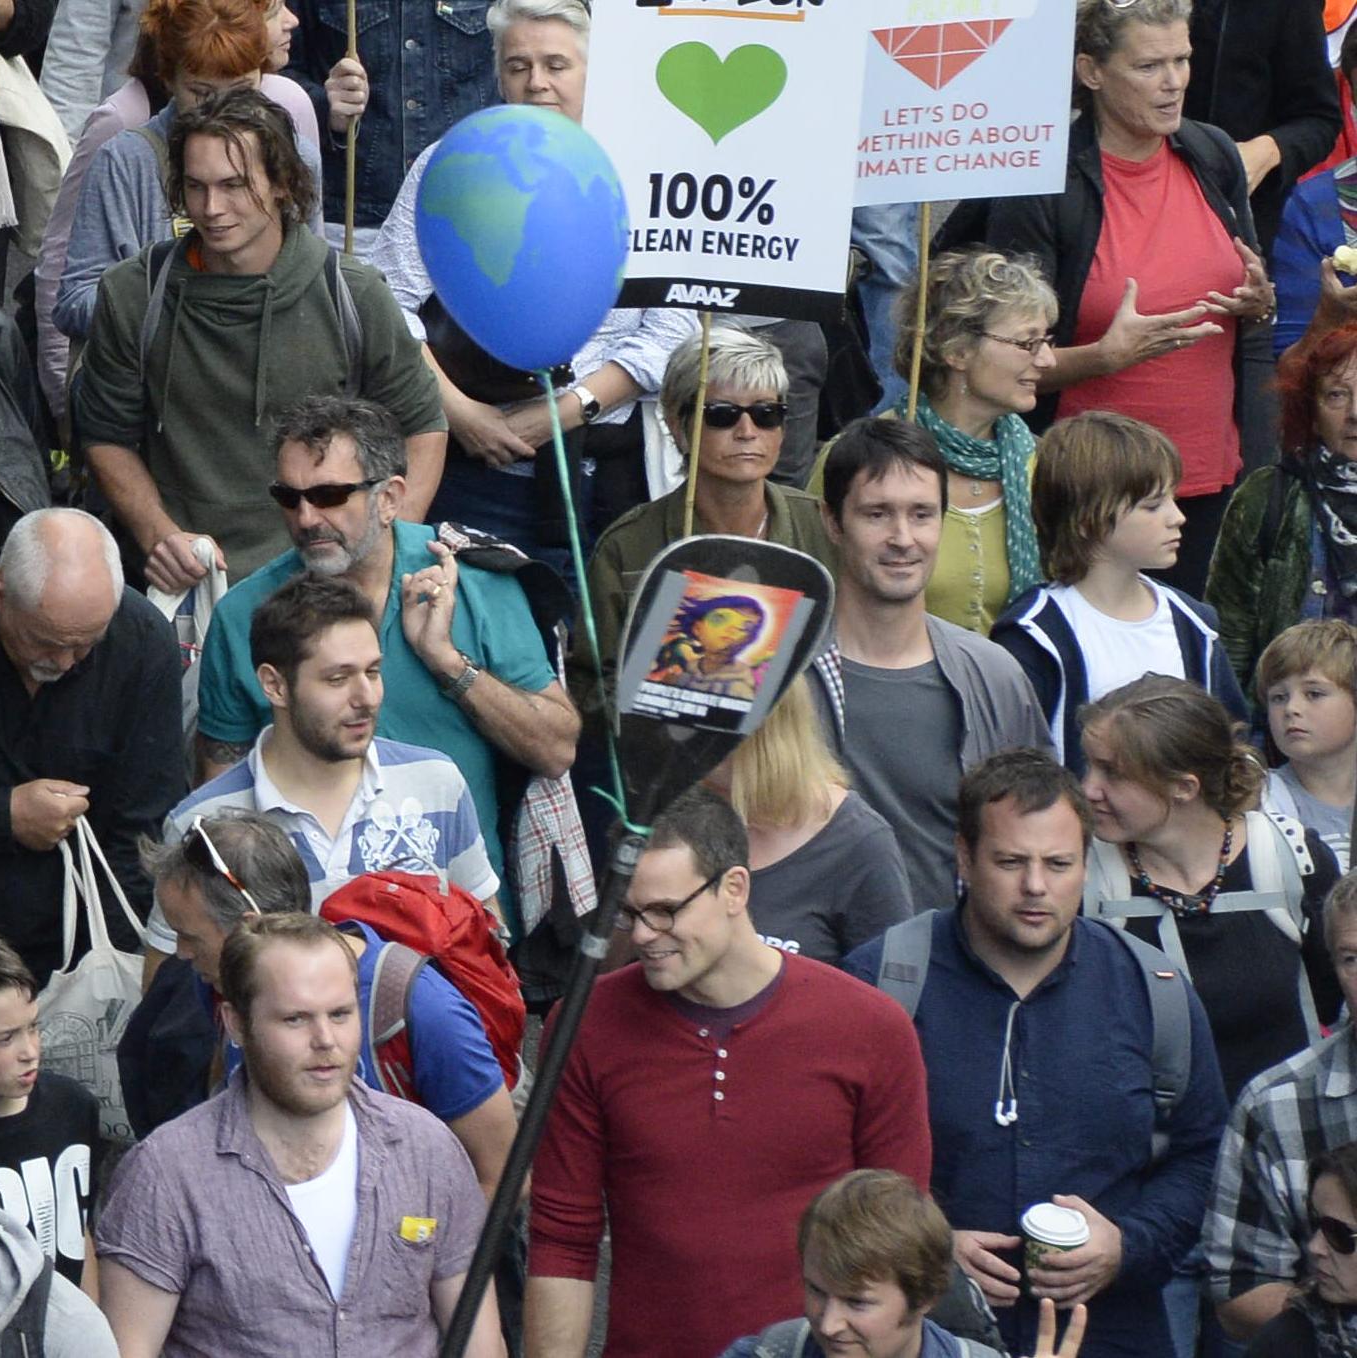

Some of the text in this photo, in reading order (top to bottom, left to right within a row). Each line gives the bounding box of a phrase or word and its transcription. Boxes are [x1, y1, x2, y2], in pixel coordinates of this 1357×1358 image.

[883, 102, 989, 126] LET'S DO
[857, 124, 1055, 153] METHING ABOUT
[857, 149, 1041, 178] IMATE CHANGE
[649, 172, 777, 226] 100%
[628, 228, 800, 262] LEAN ENERGY
[665, 283, 741, 307] AVAAZ
